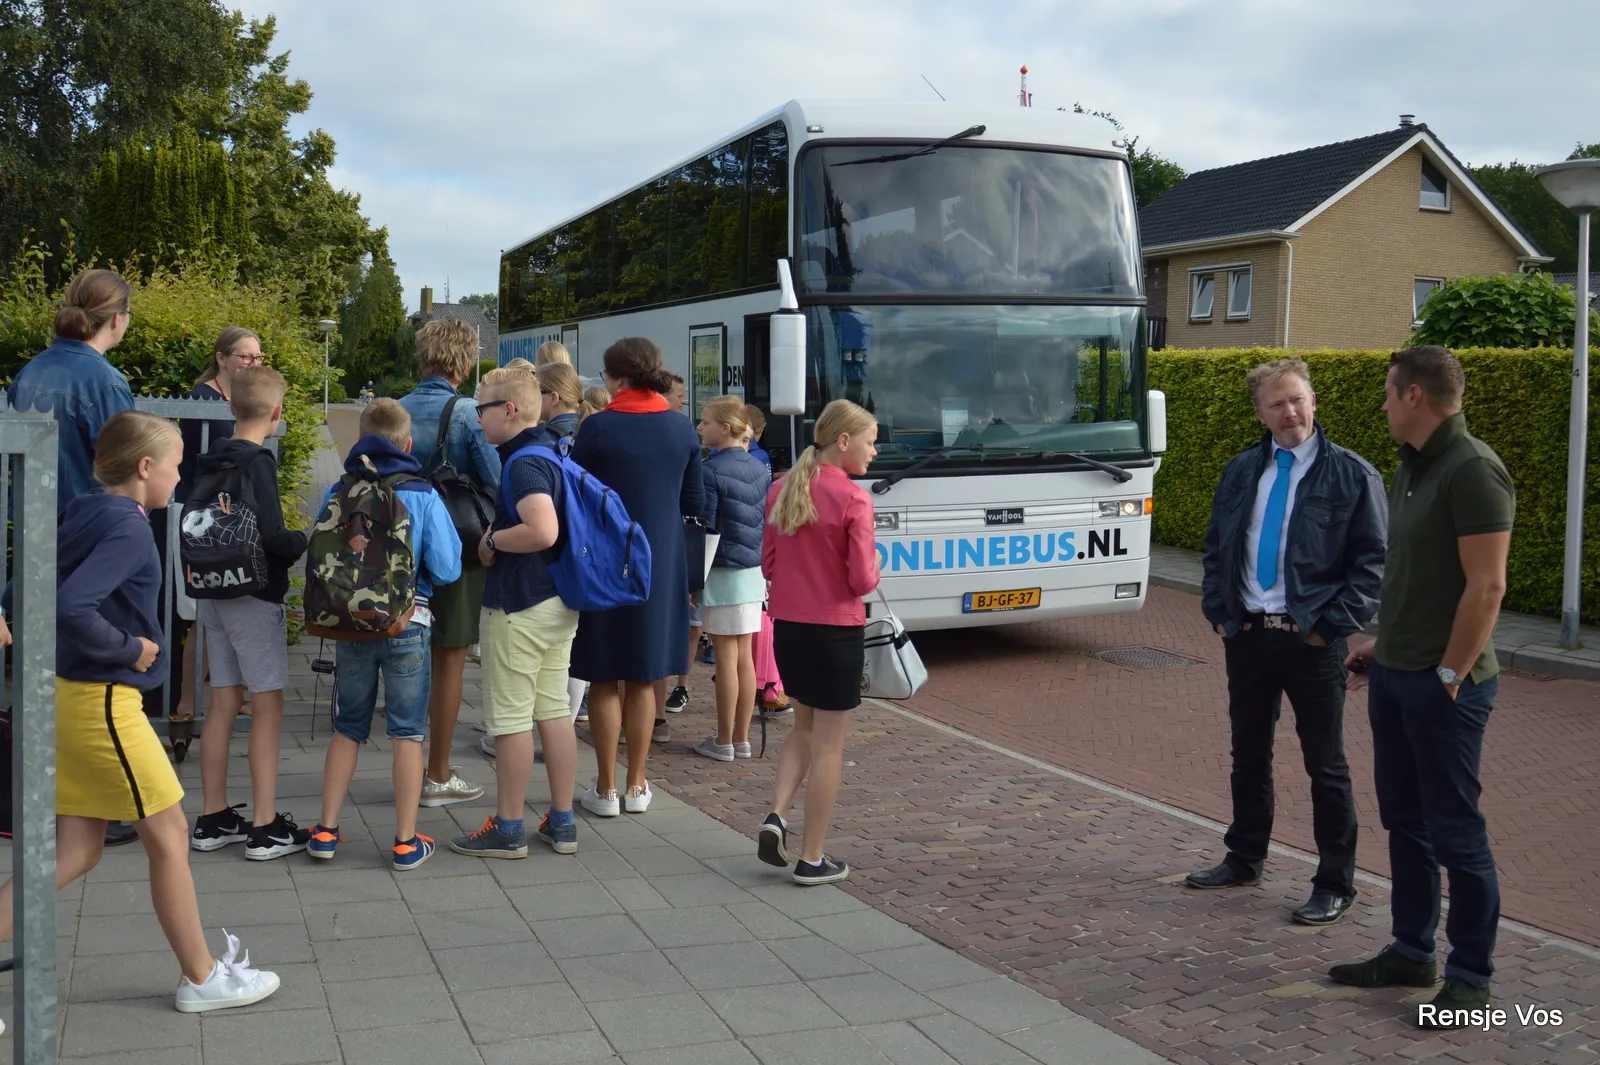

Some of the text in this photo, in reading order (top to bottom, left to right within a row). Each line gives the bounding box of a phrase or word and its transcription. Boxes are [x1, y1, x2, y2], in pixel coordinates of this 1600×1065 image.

[1572, 367, 1581, 378] 4
[190, 567, 253, 589] GOAL
[977, 592, 1033, 607] BJ-GF-37
